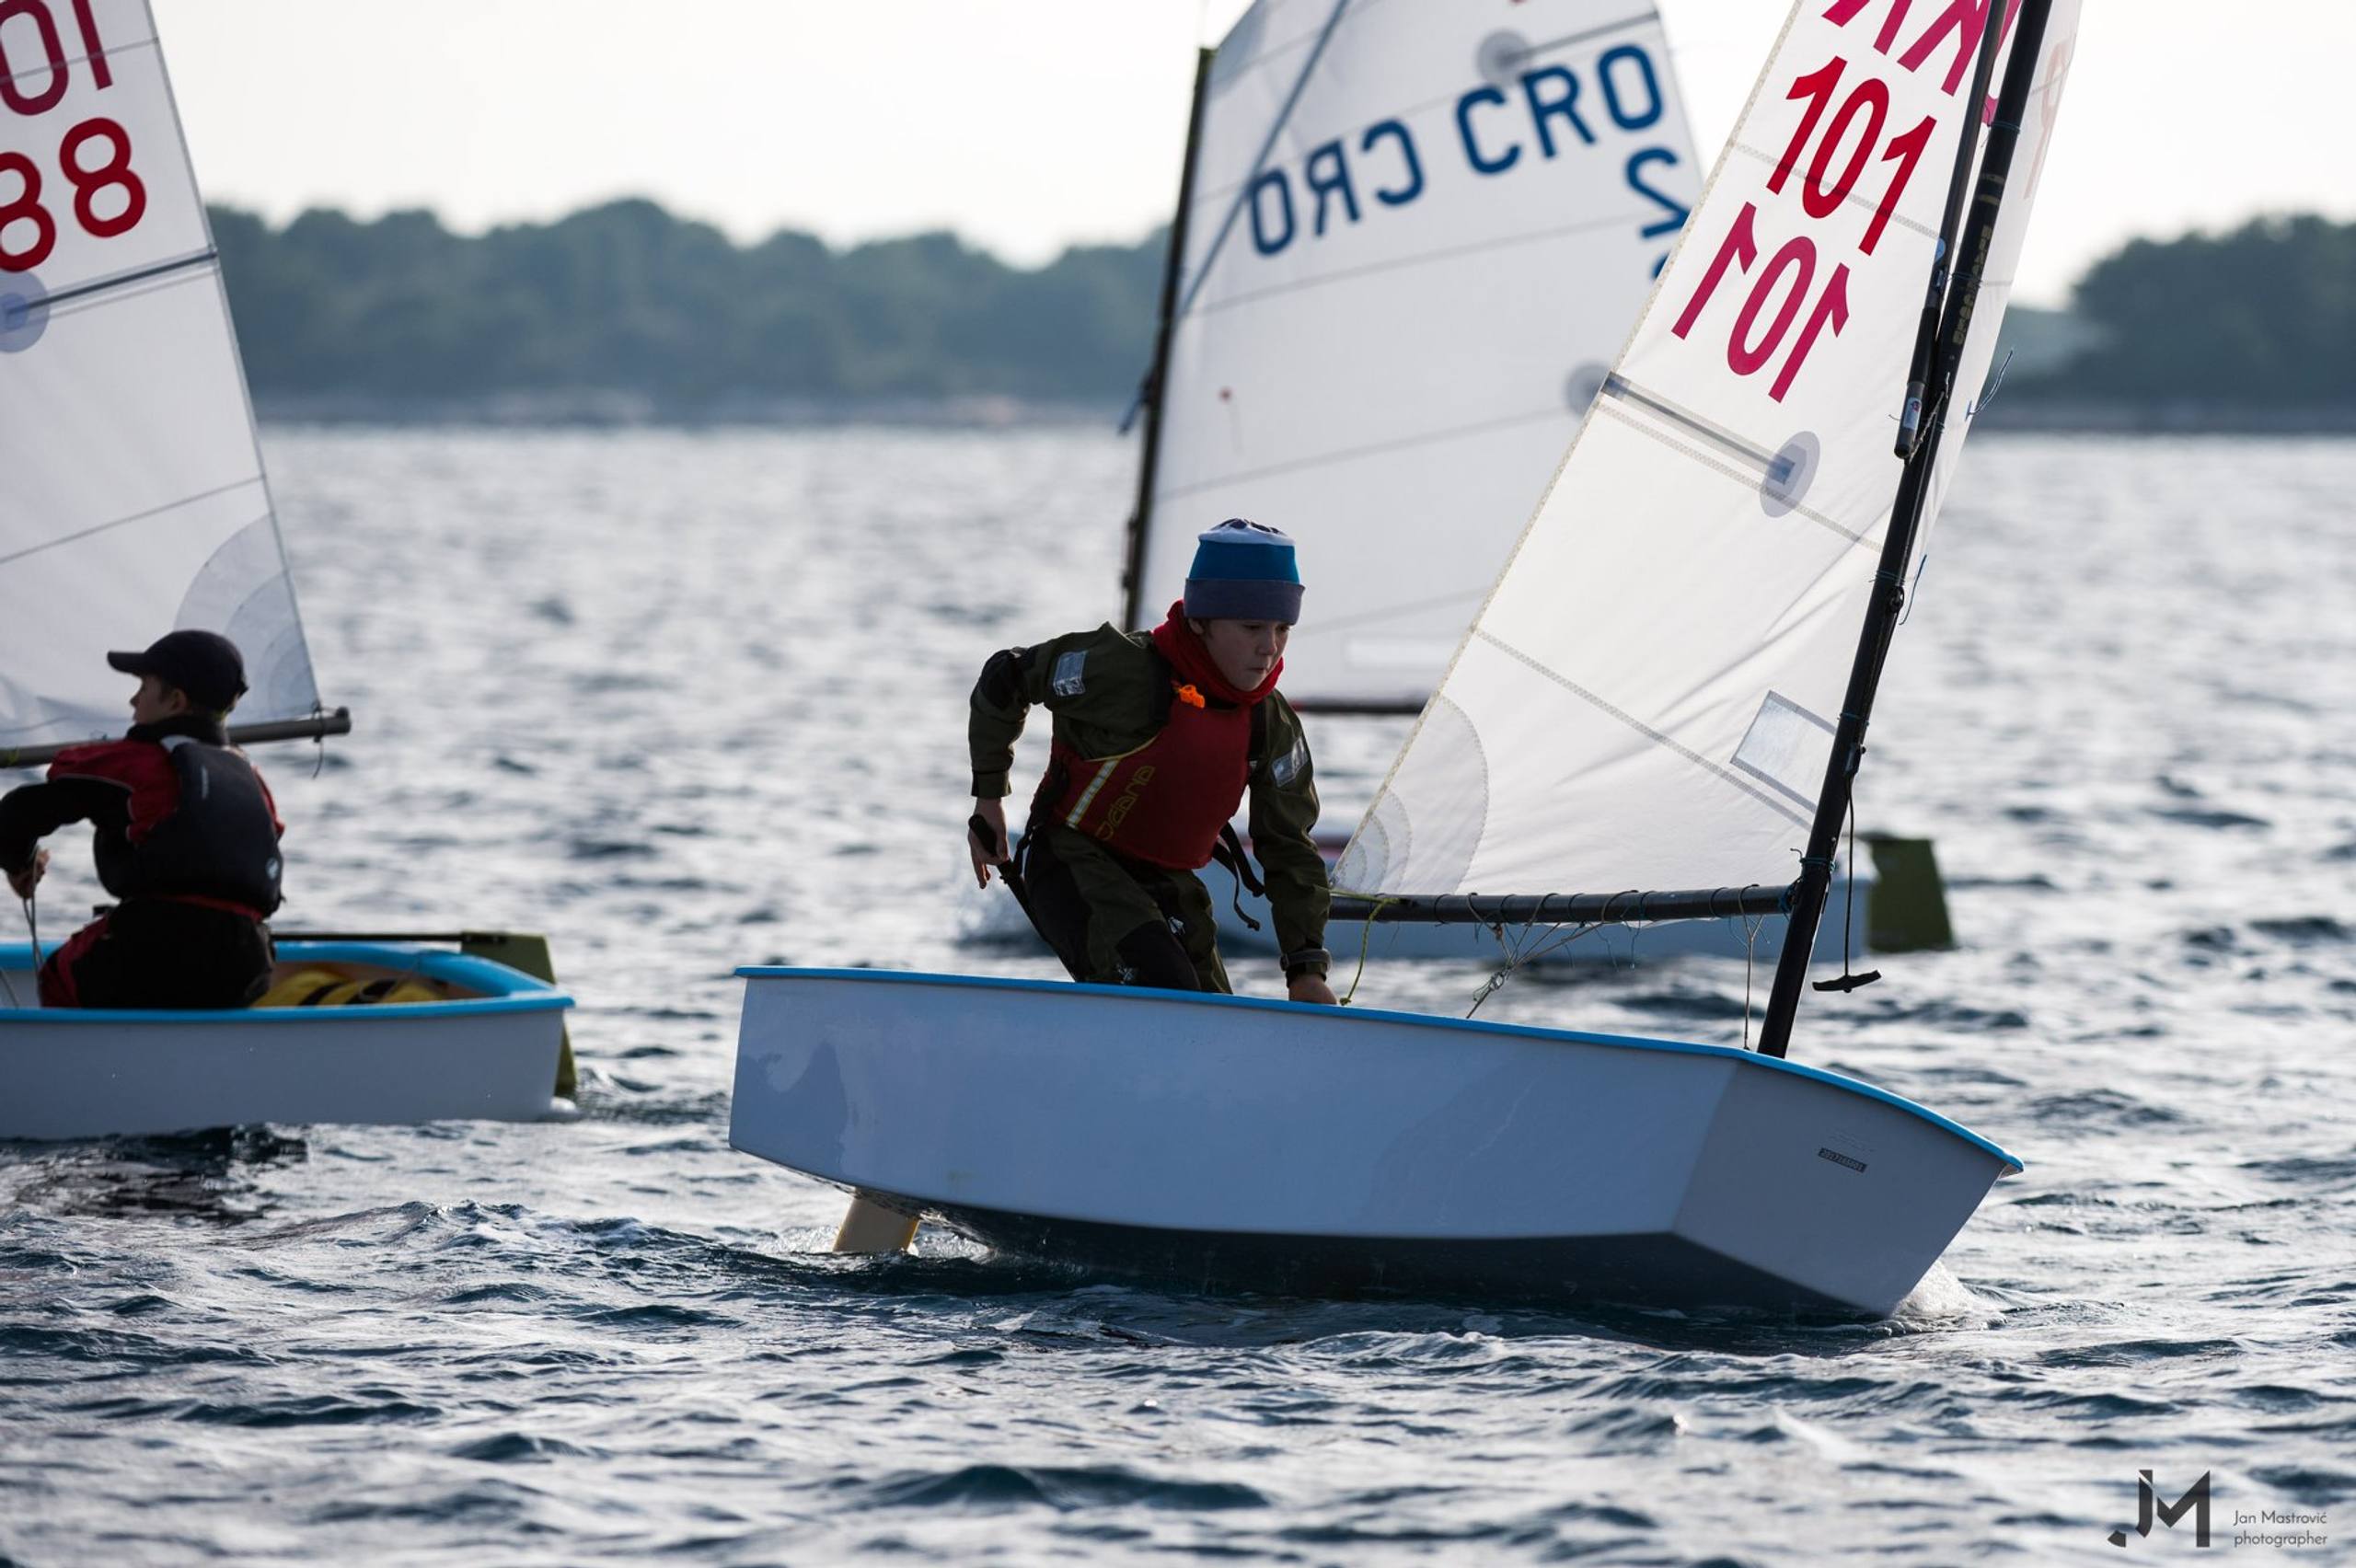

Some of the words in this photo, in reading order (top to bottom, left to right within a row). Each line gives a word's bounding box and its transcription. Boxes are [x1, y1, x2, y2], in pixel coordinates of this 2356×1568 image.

[1455, 44, 1664, 176] CRO
[1765, 55, 1937, 257] 101
[0, 117, 146, 272] 88
